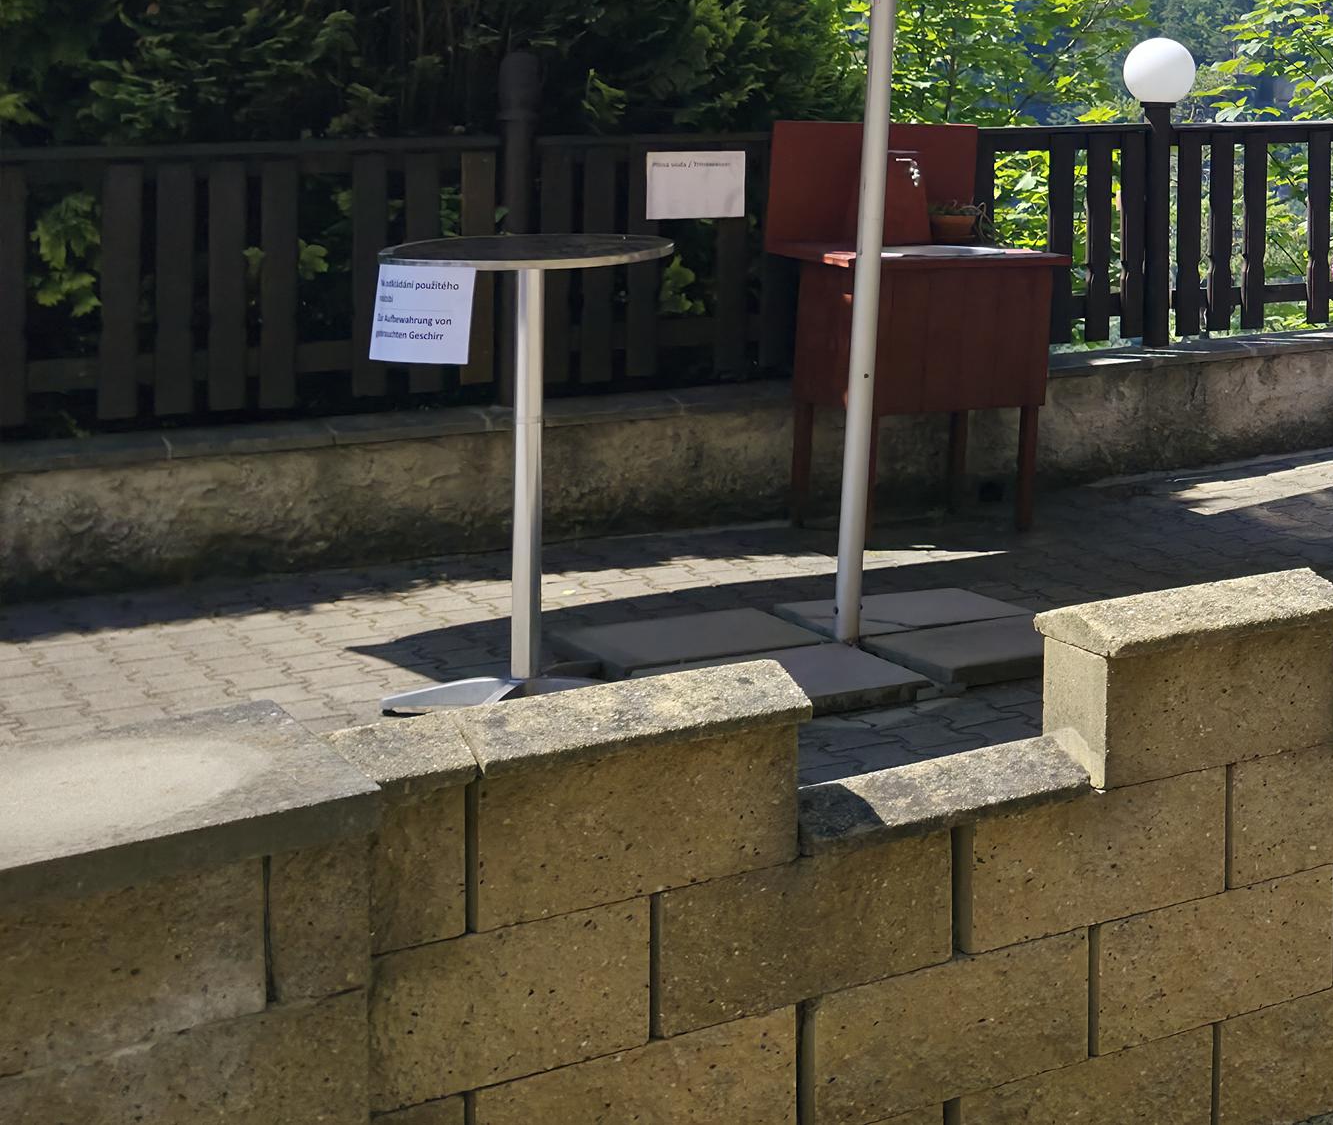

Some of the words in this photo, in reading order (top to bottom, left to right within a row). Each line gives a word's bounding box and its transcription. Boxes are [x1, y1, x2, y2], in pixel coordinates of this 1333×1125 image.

[415, 281, 460, 291] použitého
[435, 318, 452, 326] von
[409, 331, 444, 340] Geschirr
